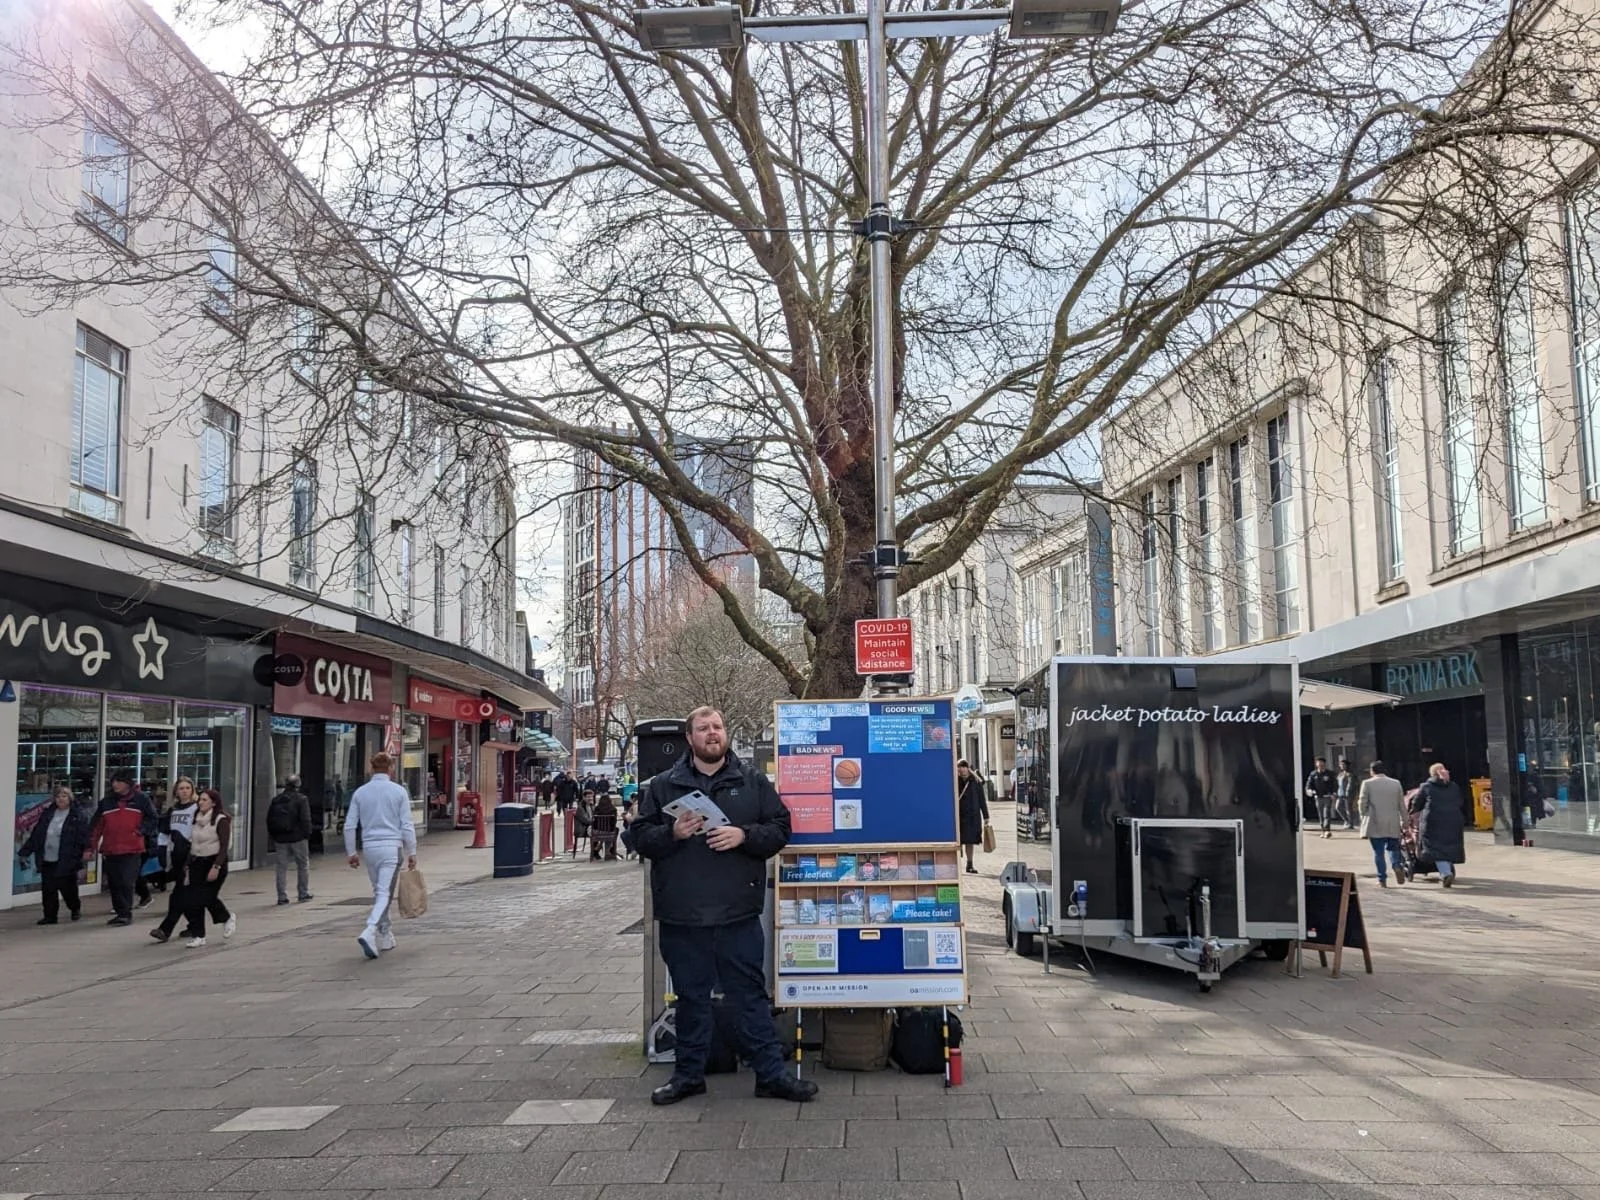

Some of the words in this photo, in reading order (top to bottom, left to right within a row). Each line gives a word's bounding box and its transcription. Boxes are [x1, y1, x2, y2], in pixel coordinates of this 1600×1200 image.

[860, 623, 908, 634] COVID-19
[0, 614, 111, 676] rug
[864, 639, 905, 648] Maintain
[871, 649, 898, 657] social
[865, 660, 905, 668] distance
[274, 665, 301, 673] COSTA
[1386, 651, 1480, 696] PRIMARK
[314, 658, 373, 703] COSTA
[1066, 704, 1136, 727] jacket
[1137, 708, 1209, 727] potato
[1212, 705, 1281, 724] ladies
[110, 729, 137, 737] BOSS
[787, 871, 803, 879] Free
[805, 870, 832, 879] leaflets
[906, 909, 931, 917] Please
[932, 909, 952, 917] take!
